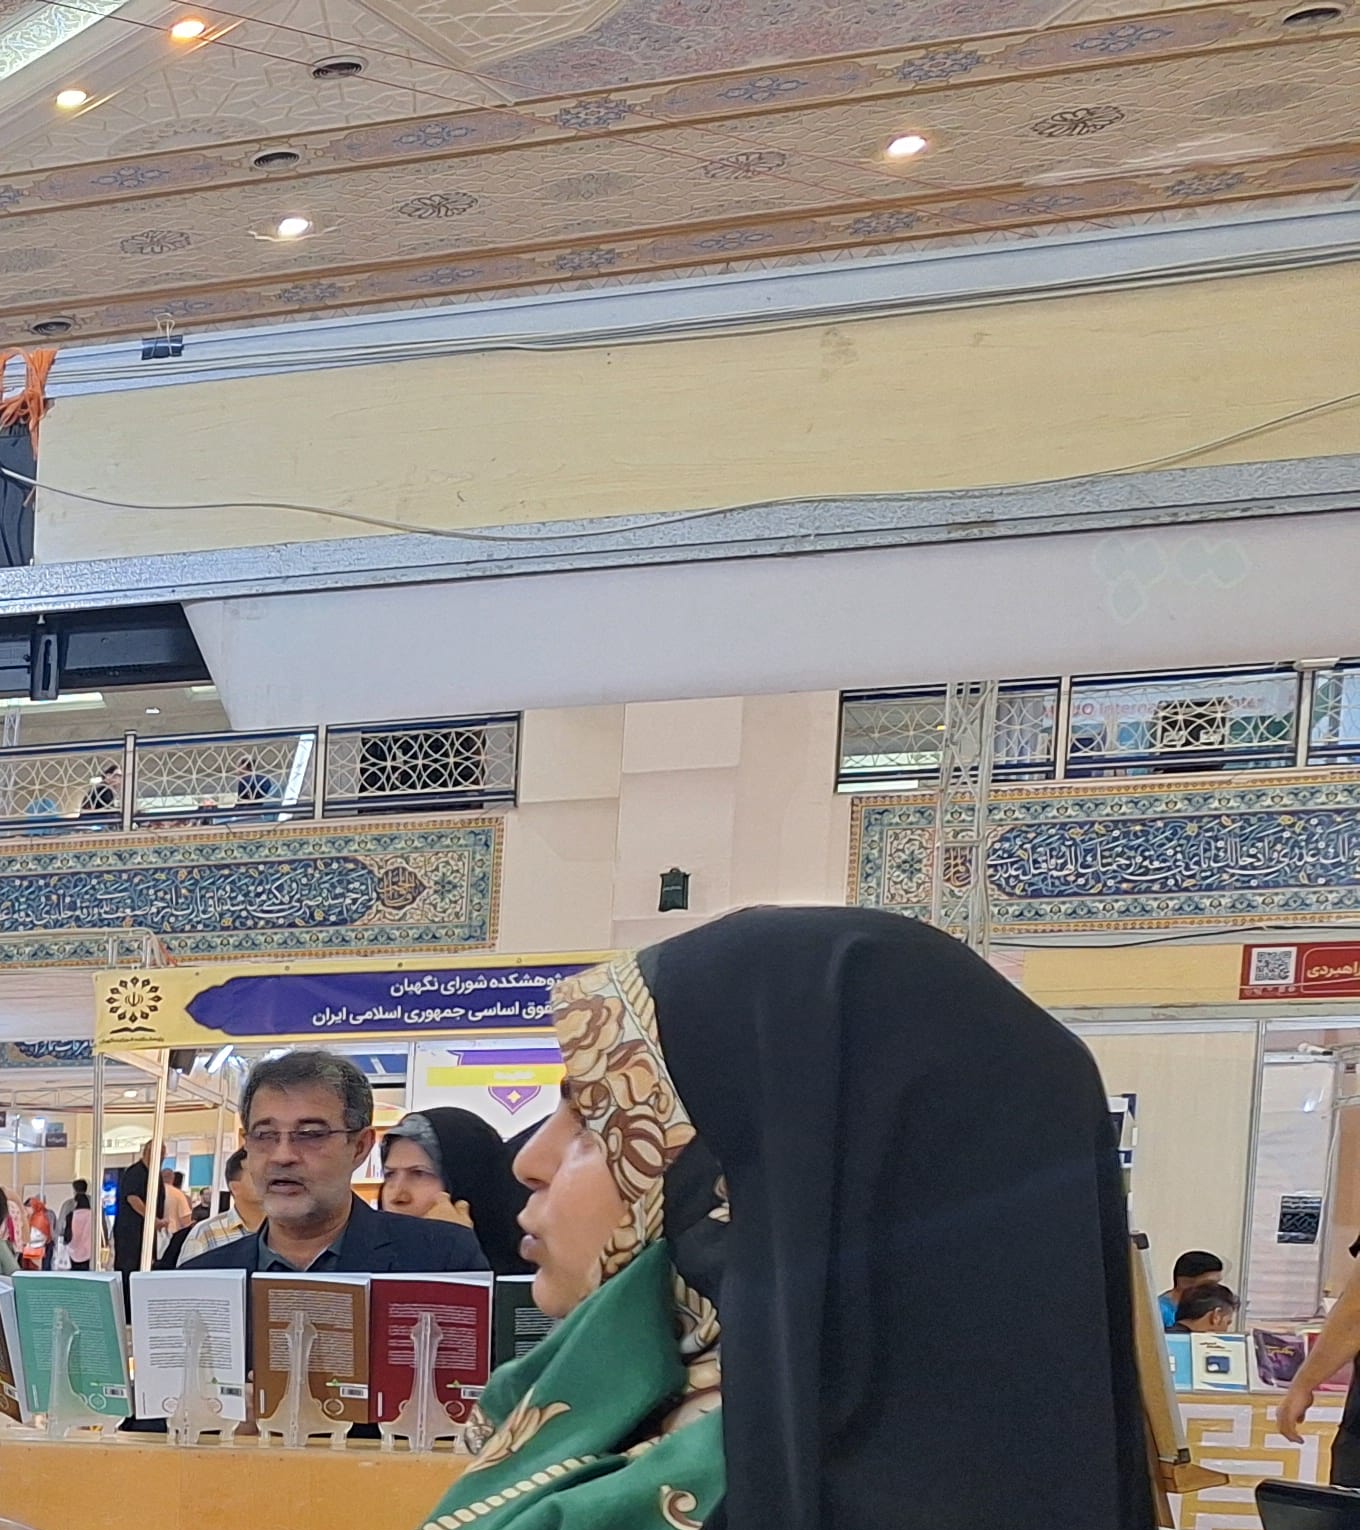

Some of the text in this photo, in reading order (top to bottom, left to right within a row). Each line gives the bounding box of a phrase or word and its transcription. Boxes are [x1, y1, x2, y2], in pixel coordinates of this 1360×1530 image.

[390, 978, 438, 997] نگهبان
[441, 976, 486, 995] شورای
[311, 1001, 554, 1028] قوق اساسی جمهوری اسلامی ایران
